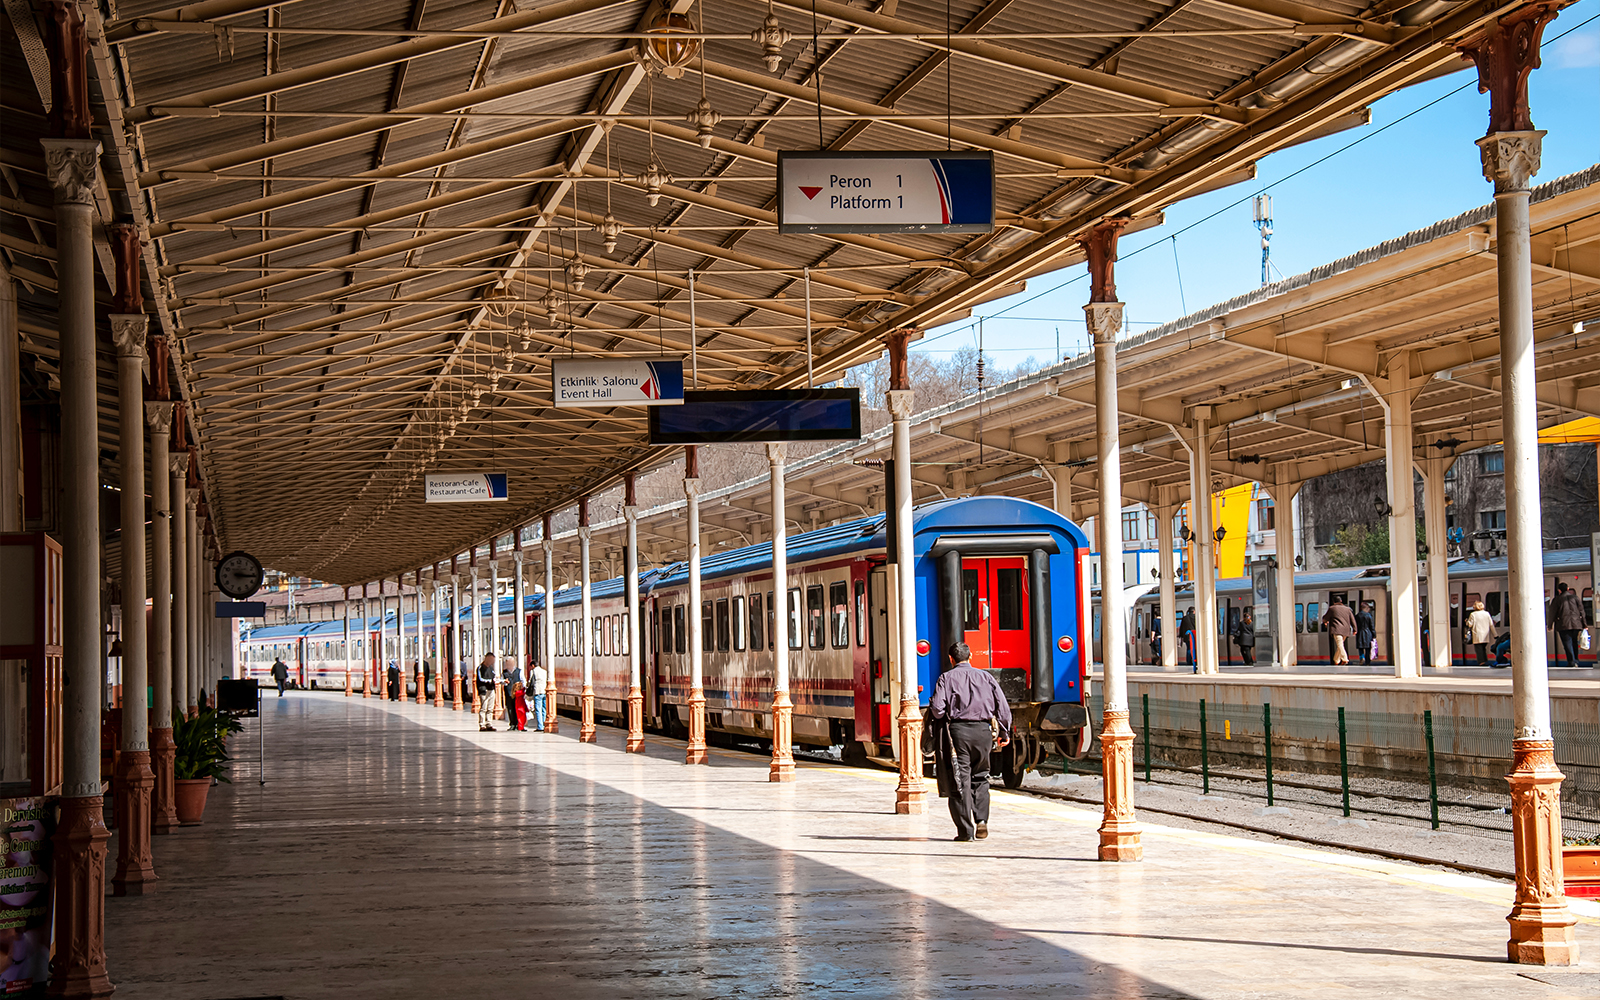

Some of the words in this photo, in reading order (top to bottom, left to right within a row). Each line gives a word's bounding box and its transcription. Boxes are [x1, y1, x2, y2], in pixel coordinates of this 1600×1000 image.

[830, 174, 871, 188] Peron
[896, 174, 902, 188] 1
[830, 195, 891, 208] Platform
[897, 196, 902, 208] 1
[560, 377, 597, 387] Etkinlik
[602, 376, 638, 386] Salonu
[561, 390, 590, 399] Event
[592, 388, 612, 398] Hall
[430, 480, 480, 488] Restoran-Cafe
[430, 487, 486, 496] Restaurant-Cafe
[4, 804, 51, 823] Dervishes
[0, 864, 40, 879] eremony
